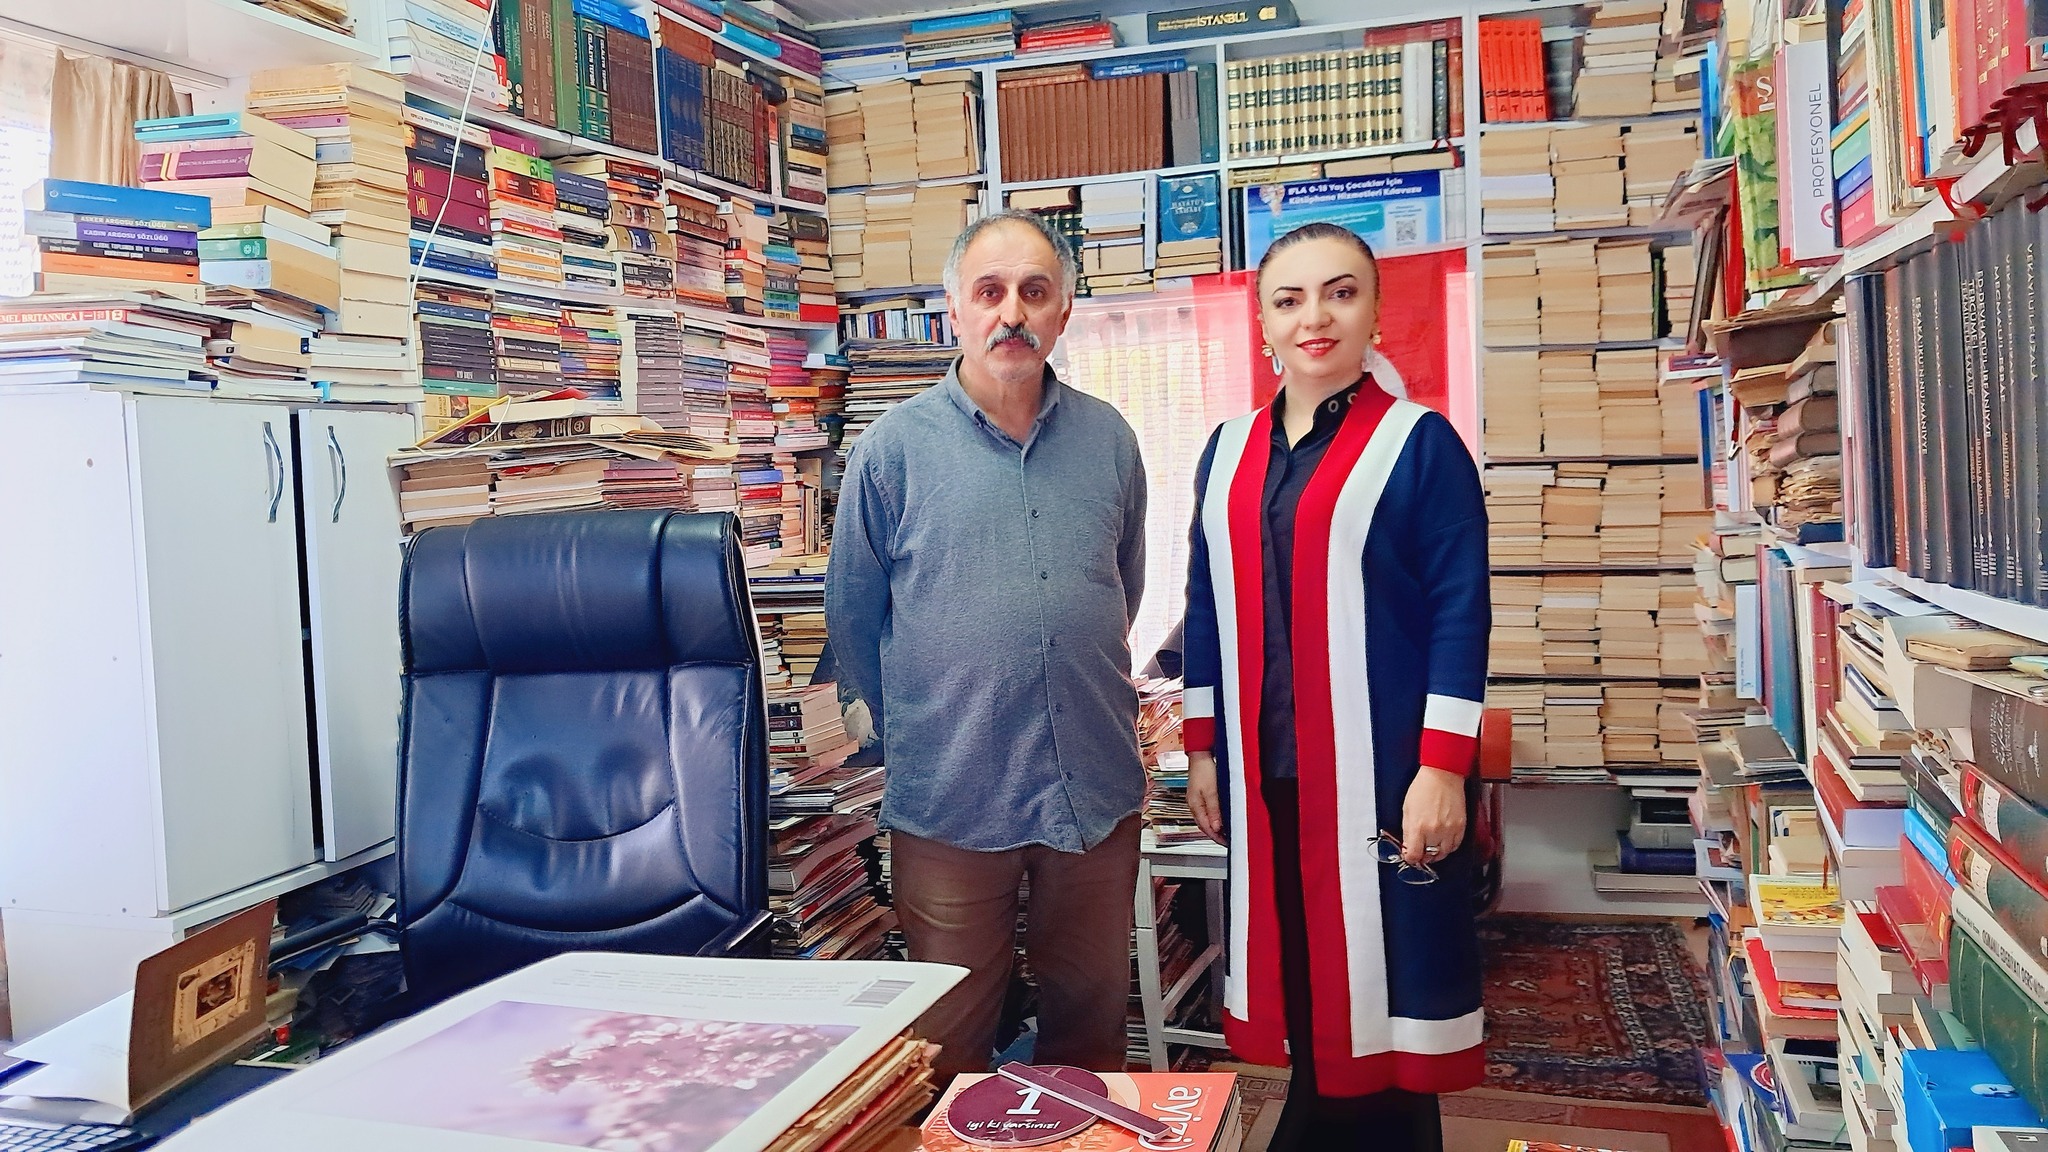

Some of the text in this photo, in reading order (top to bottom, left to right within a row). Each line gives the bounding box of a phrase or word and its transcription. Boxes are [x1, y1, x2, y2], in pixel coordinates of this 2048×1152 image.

[1808, 83, 1825, 198] PROFESYONEL
[1288, 186, 1306, 196] IFLA
[1329, 183, 1344, 193] Yaş
[1346, 180, 1386, 191] Çocuklar
[1387, 177, 1403, 186] İçin
[1288, 185, 1422, 204] Kütüphane Hizmetleri Kılavuzu
[105, 217, 134, 227] ARGOSU
[135, 218, 167, 229] SÖZLÜĞÜ
[83, 229, 169, 242] KADIN ARGOSU SÖZLÜĞÜ
[21, 311, 78, 323] BRITANNICA
[1006, 1087, 1042, 1115] 1
